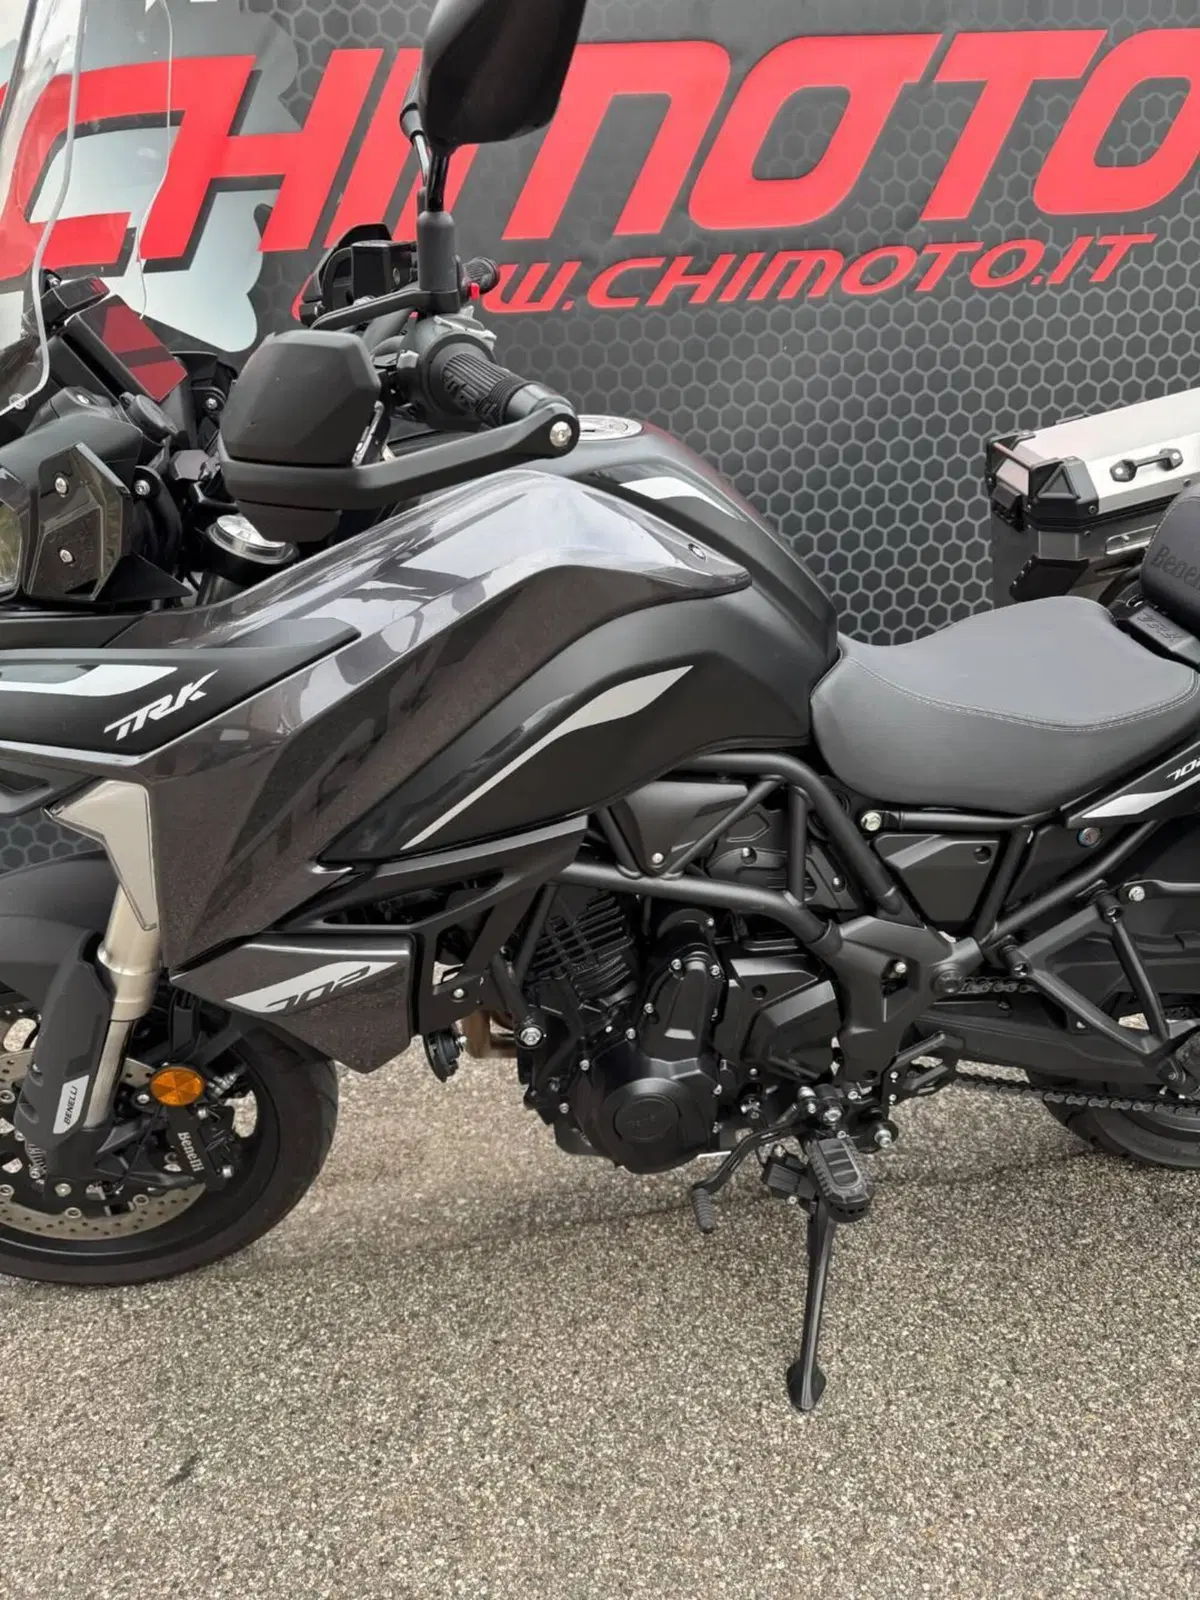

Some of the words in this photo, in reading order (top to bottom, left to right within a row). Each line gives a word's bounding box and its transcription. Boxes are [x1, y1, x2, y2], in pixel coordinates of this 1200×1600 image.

[291, 233, 1157, 321] W.CHIMOTO.IT
[104, 669, 219, 741] TRK
[1166, 758, 1200, 781] 70
[264, 965, 372, 1014] 702
[63, 1085, 79, 1125] BENELLI
[177, 1132, 205, 1172] Benelli
